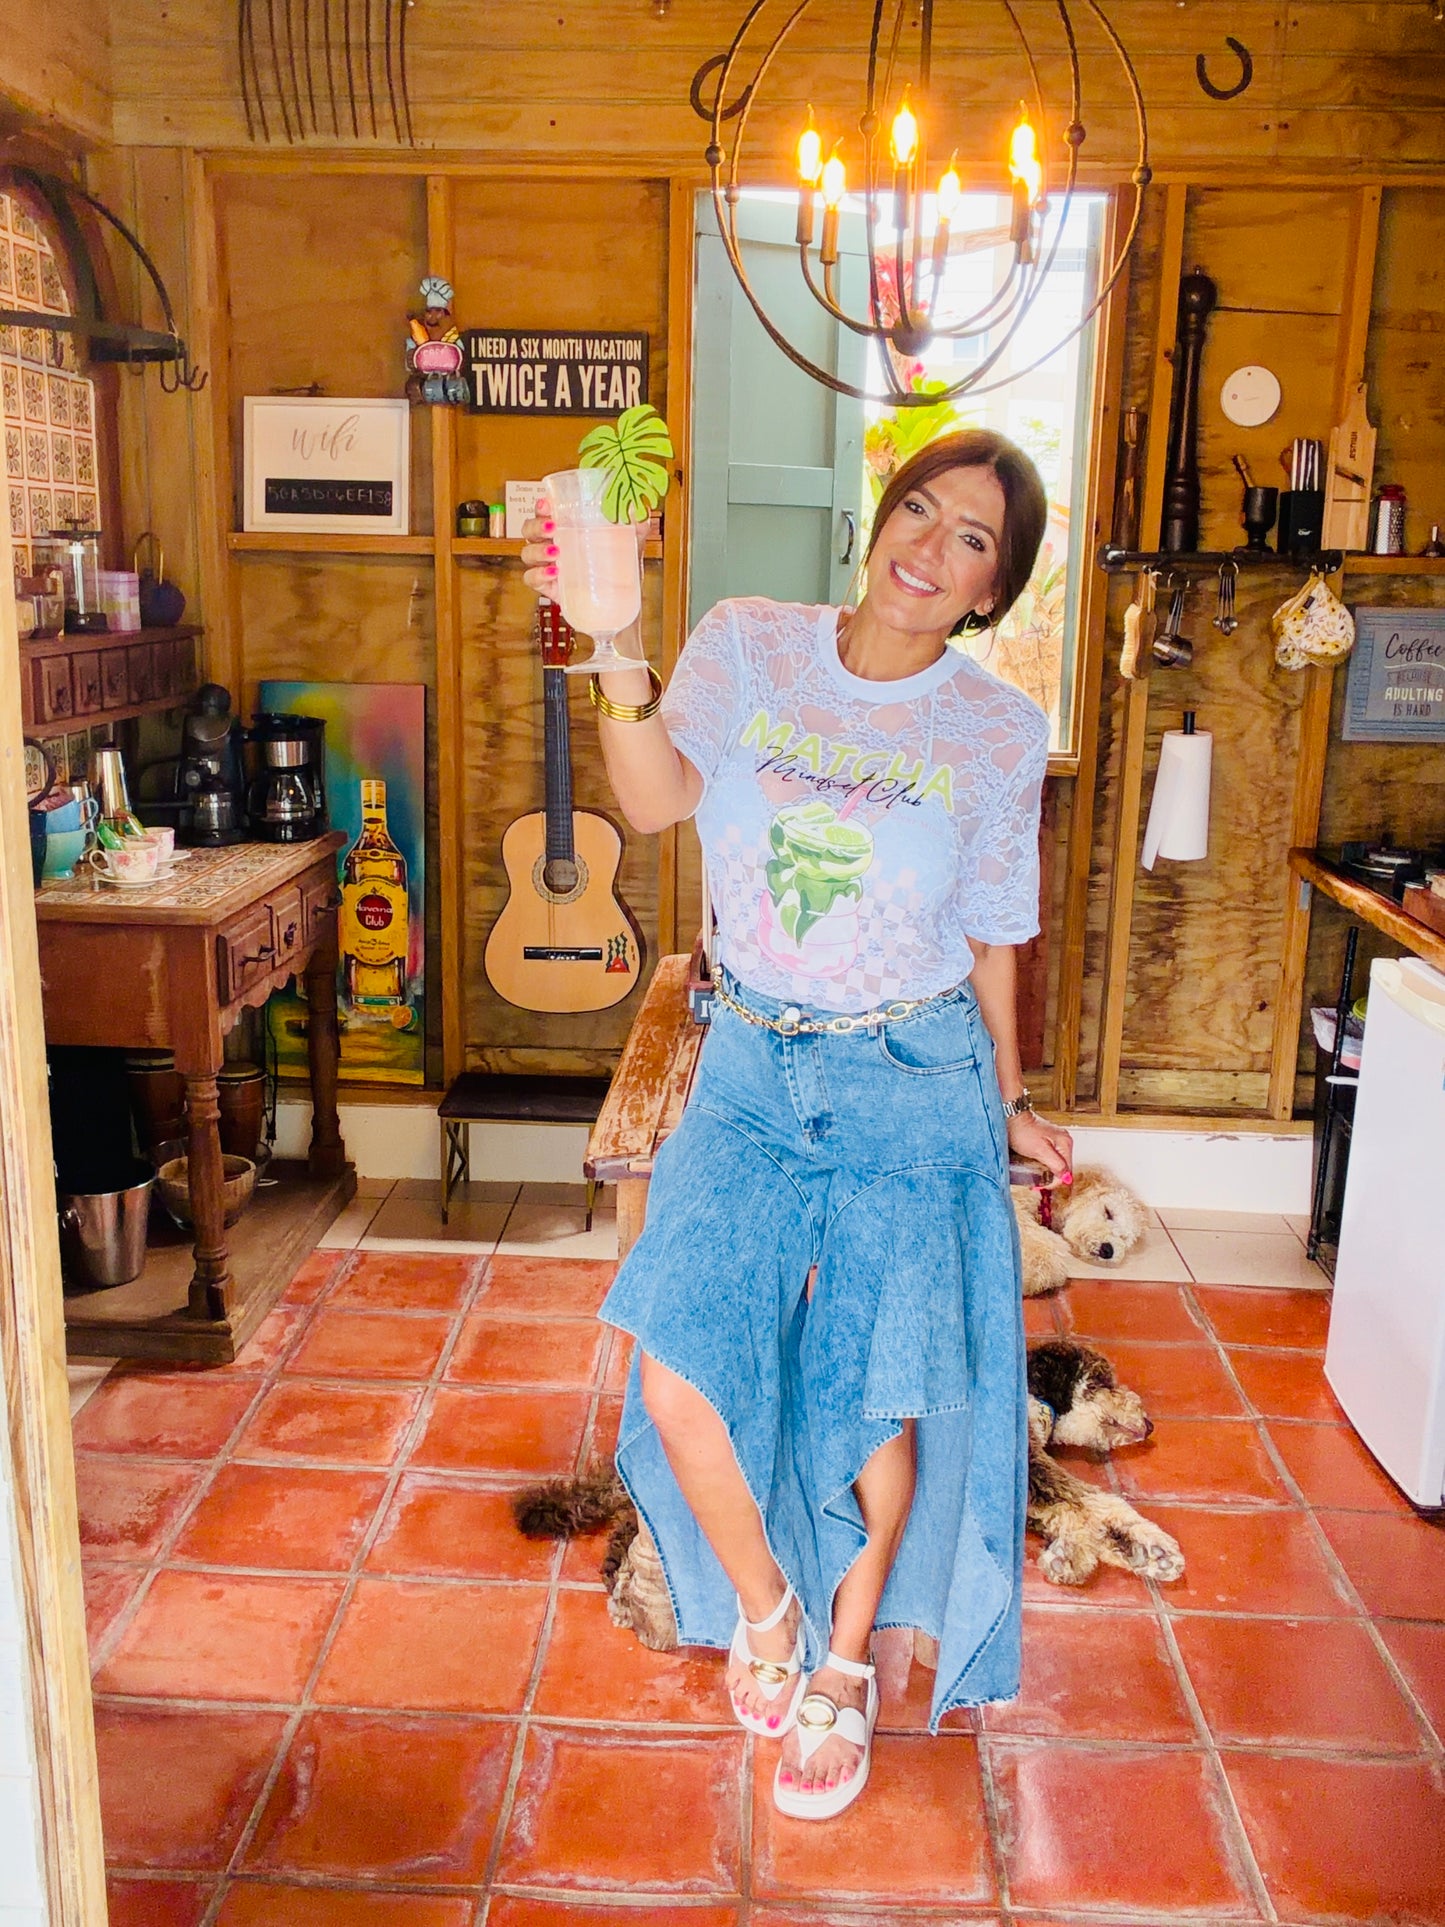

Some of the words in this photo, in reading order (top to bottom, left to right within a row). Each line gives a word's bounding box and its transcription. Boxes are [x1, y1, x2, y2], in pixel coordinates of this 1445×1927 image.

[471, 337, 476, 358] I
[478, 337, 507, 359] NEED
[509, 338, 518, 359] A
[520, 338, 540, 359] SIX
[542, 338, 582, 360] MONTH
[585, 339, 642, 361] VACATION
[471, 363, 547, 407] TWICE
[554, 364, 572, 408] A
[578, 365, 642, 409] YEAR
[292, 414, 360, 460] wifi
[1385, 633, 1444, 662] Coffee
[1384, 687, 1444, 702] ADULTING
[1393, 704, 1402, 716] IS
[1406, 704, 1431, 717] HARD
[740, 710, 953, 812] MATCHA
[755, 746, 876, 798] Mindset
[866, 772, 924, 809] Club
[355, 903, 393, 915] Havana
[365, 915, 385, 927] Club
